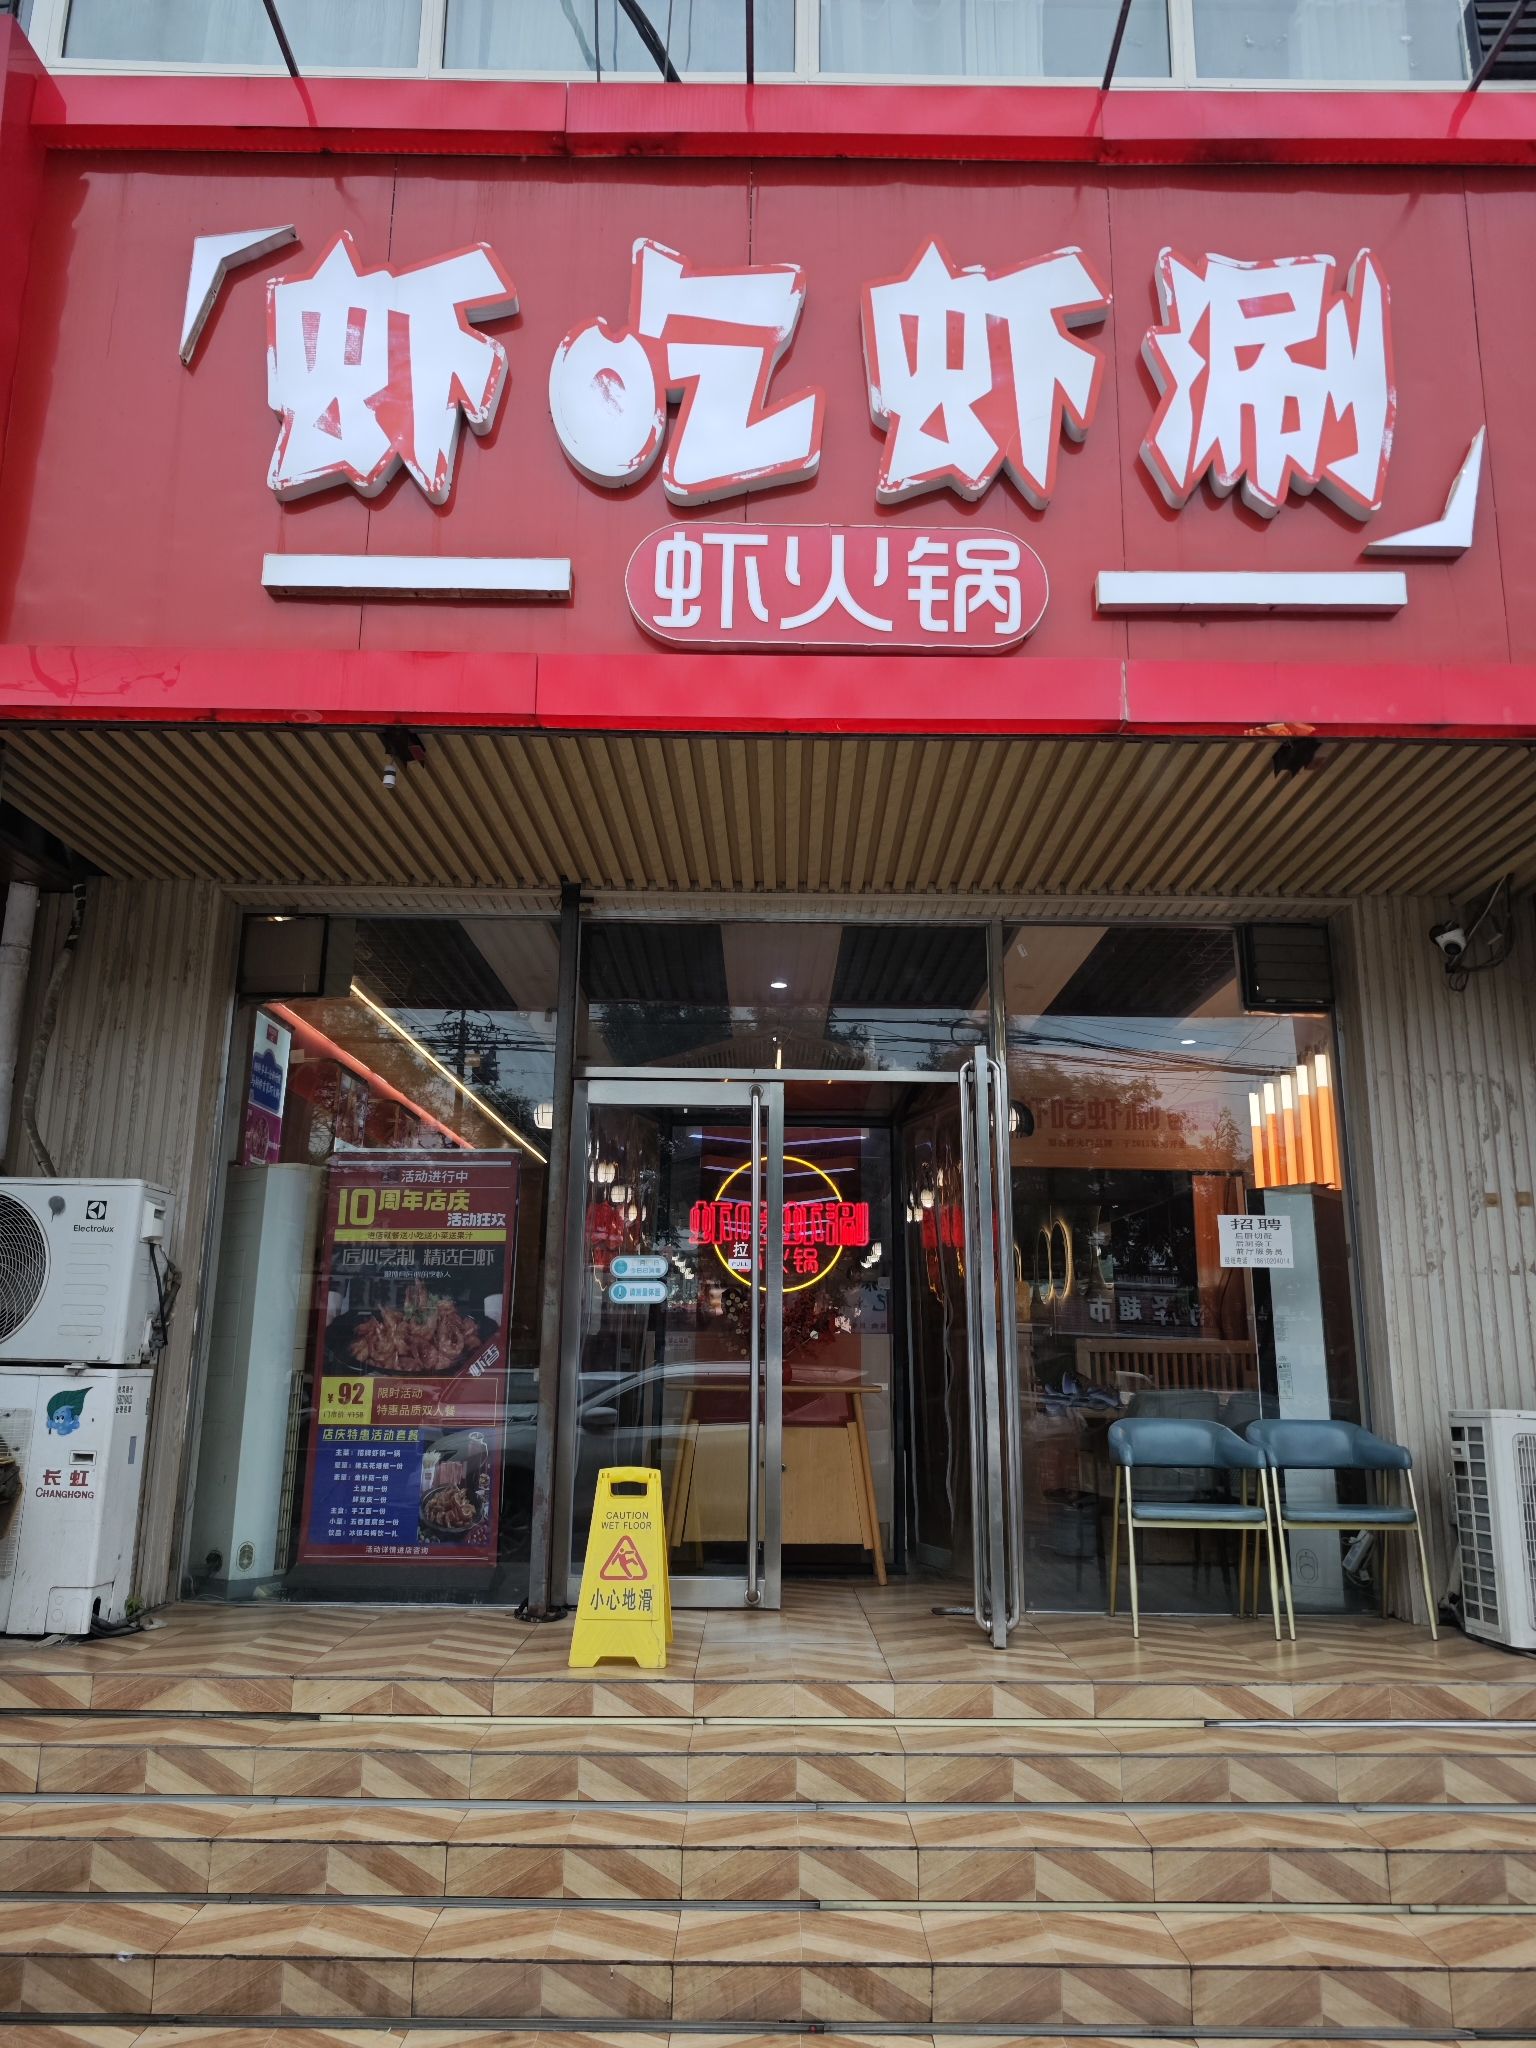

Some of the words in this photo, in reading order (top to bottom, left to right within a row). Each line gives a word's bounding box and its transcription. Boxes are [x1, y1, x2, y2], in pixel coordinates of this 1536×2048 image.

[264, 231, 1397, 522] 虾吃虾涮
[653, 532, 1022, 637] 虾火锅
[401, 1169, 469, 1184] 活动进行中
[447, 1212, 506, 1227] 活动狂欢
[1230, 1218, 1283, 1231] 招聘
[73, 1224, 115, 1233] Electrolux
[732, 1241, 749, 1258] 拉
[342, 1248, 415, 1266] 匠心烹制
[423, 1248, 497, 1266] 精选白虾
[377, 1387, 423, 1399] 限时活动
[376, 1404, 456, 1417] 特惠品质双人餐
[322, 1428, 419, 1441] 店庆特惠活动套餐
[42, 1469, 90, 1487] 长虹
[35, 1487, 95, 1499] CHANGHONG
[606, 1511, 649, 1520] CAUTION
[601, 1521, 619, 1530] WET
[623, 1521, 652, 1530] FLOOR
[365, 1545, 429, 1555] 活动详情进店咨询
[590, 1587, 653, 1612] 小心地滑
